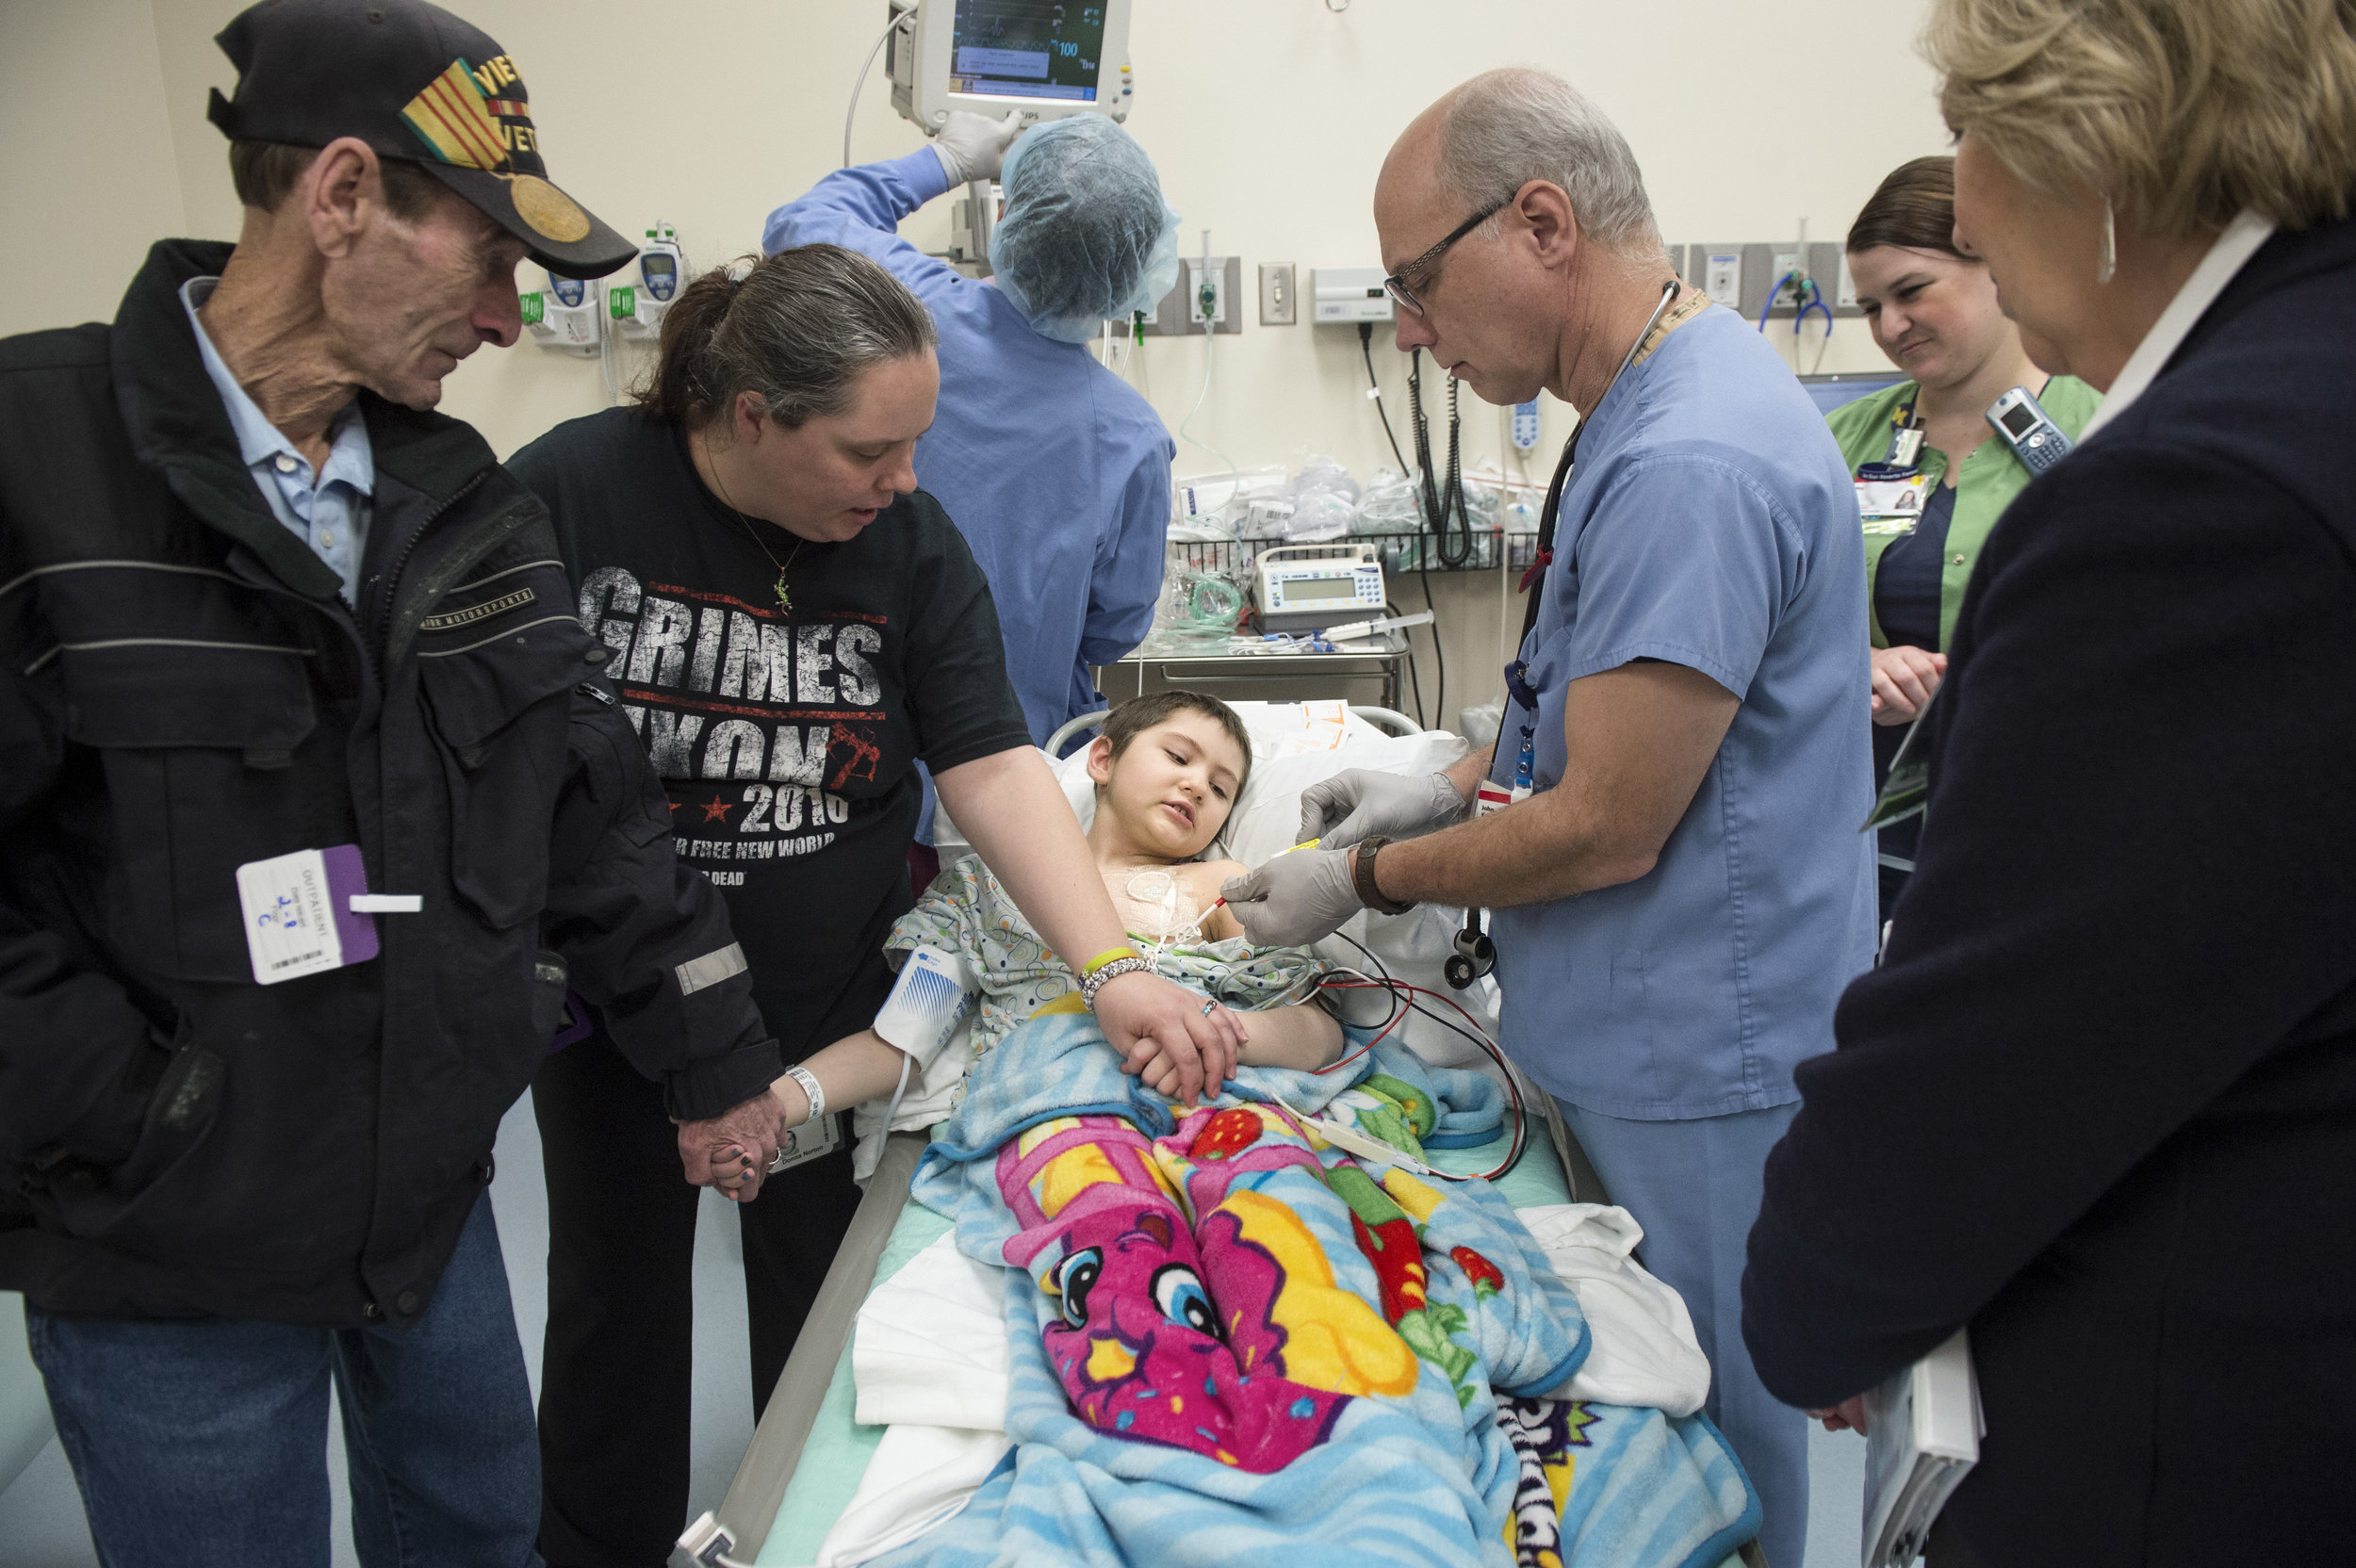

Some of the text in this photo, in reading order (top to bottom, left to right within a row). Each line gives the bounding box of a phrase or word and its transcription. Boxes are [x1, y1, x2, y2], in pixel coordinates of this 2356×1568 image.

[1059, 41, 1078, 57] 100
[446, 591, 530, 625] MOTORSPORTS
[579, 565, 883, 707] GRIMES
[690, 839, 732, 859] FREE
[735, 840, 776, 859] NEW
[712, 871, 744, 886] DEAD
[303, 869, 328, 938] OUTPATIENT
[782, 1145, 824, 1165] Donna Norton
